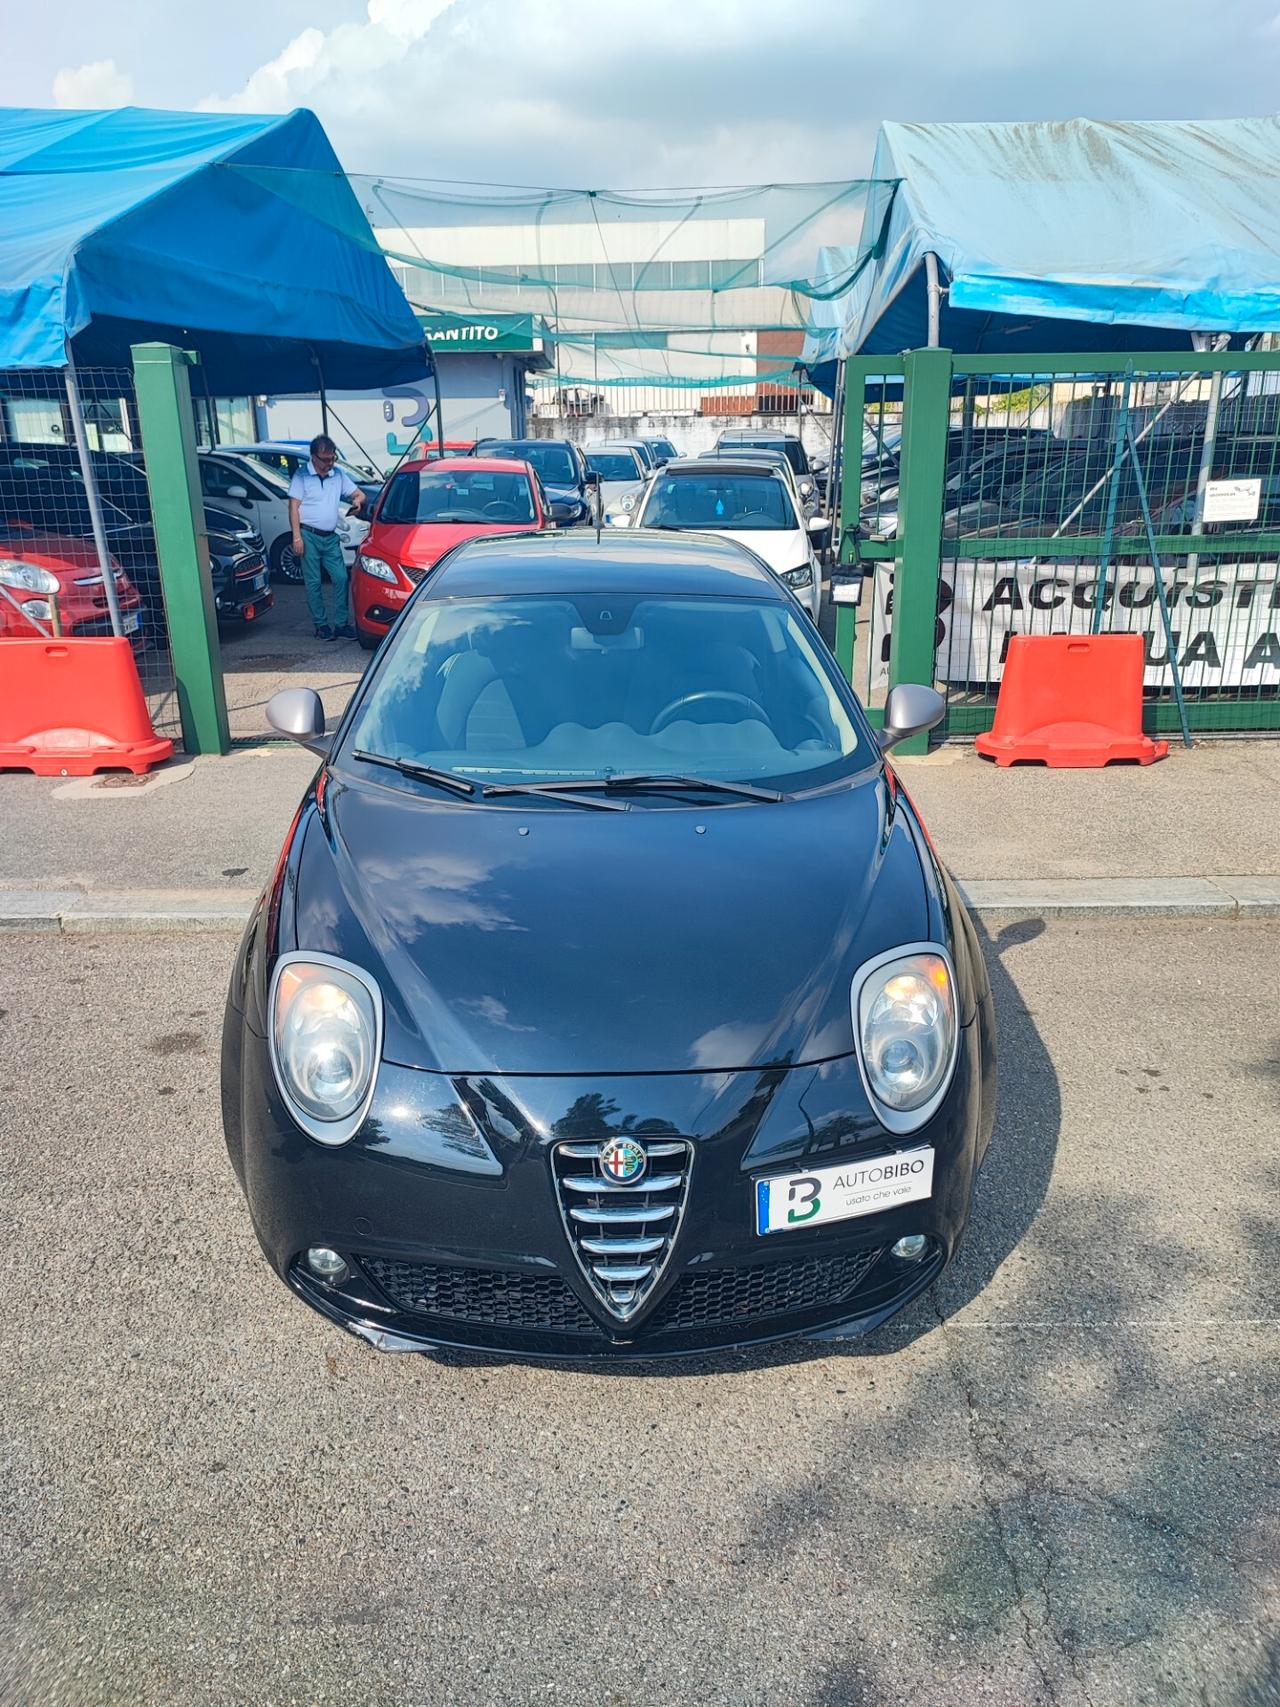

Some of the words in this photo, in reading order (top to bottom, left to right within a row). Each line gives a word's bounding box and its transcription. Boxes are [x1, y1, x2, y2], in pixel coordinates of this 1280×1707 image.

[1099, 630, 1222, 669] UA
[623, 1142, 644, 1163] ROMEO
[832, 1159, 925, 1191] AUTOBIBO
[845, 1194, 871, 1207] usato
[872, 1189, 891, 1201] che
[892, 1185, 912, 1196] vale
